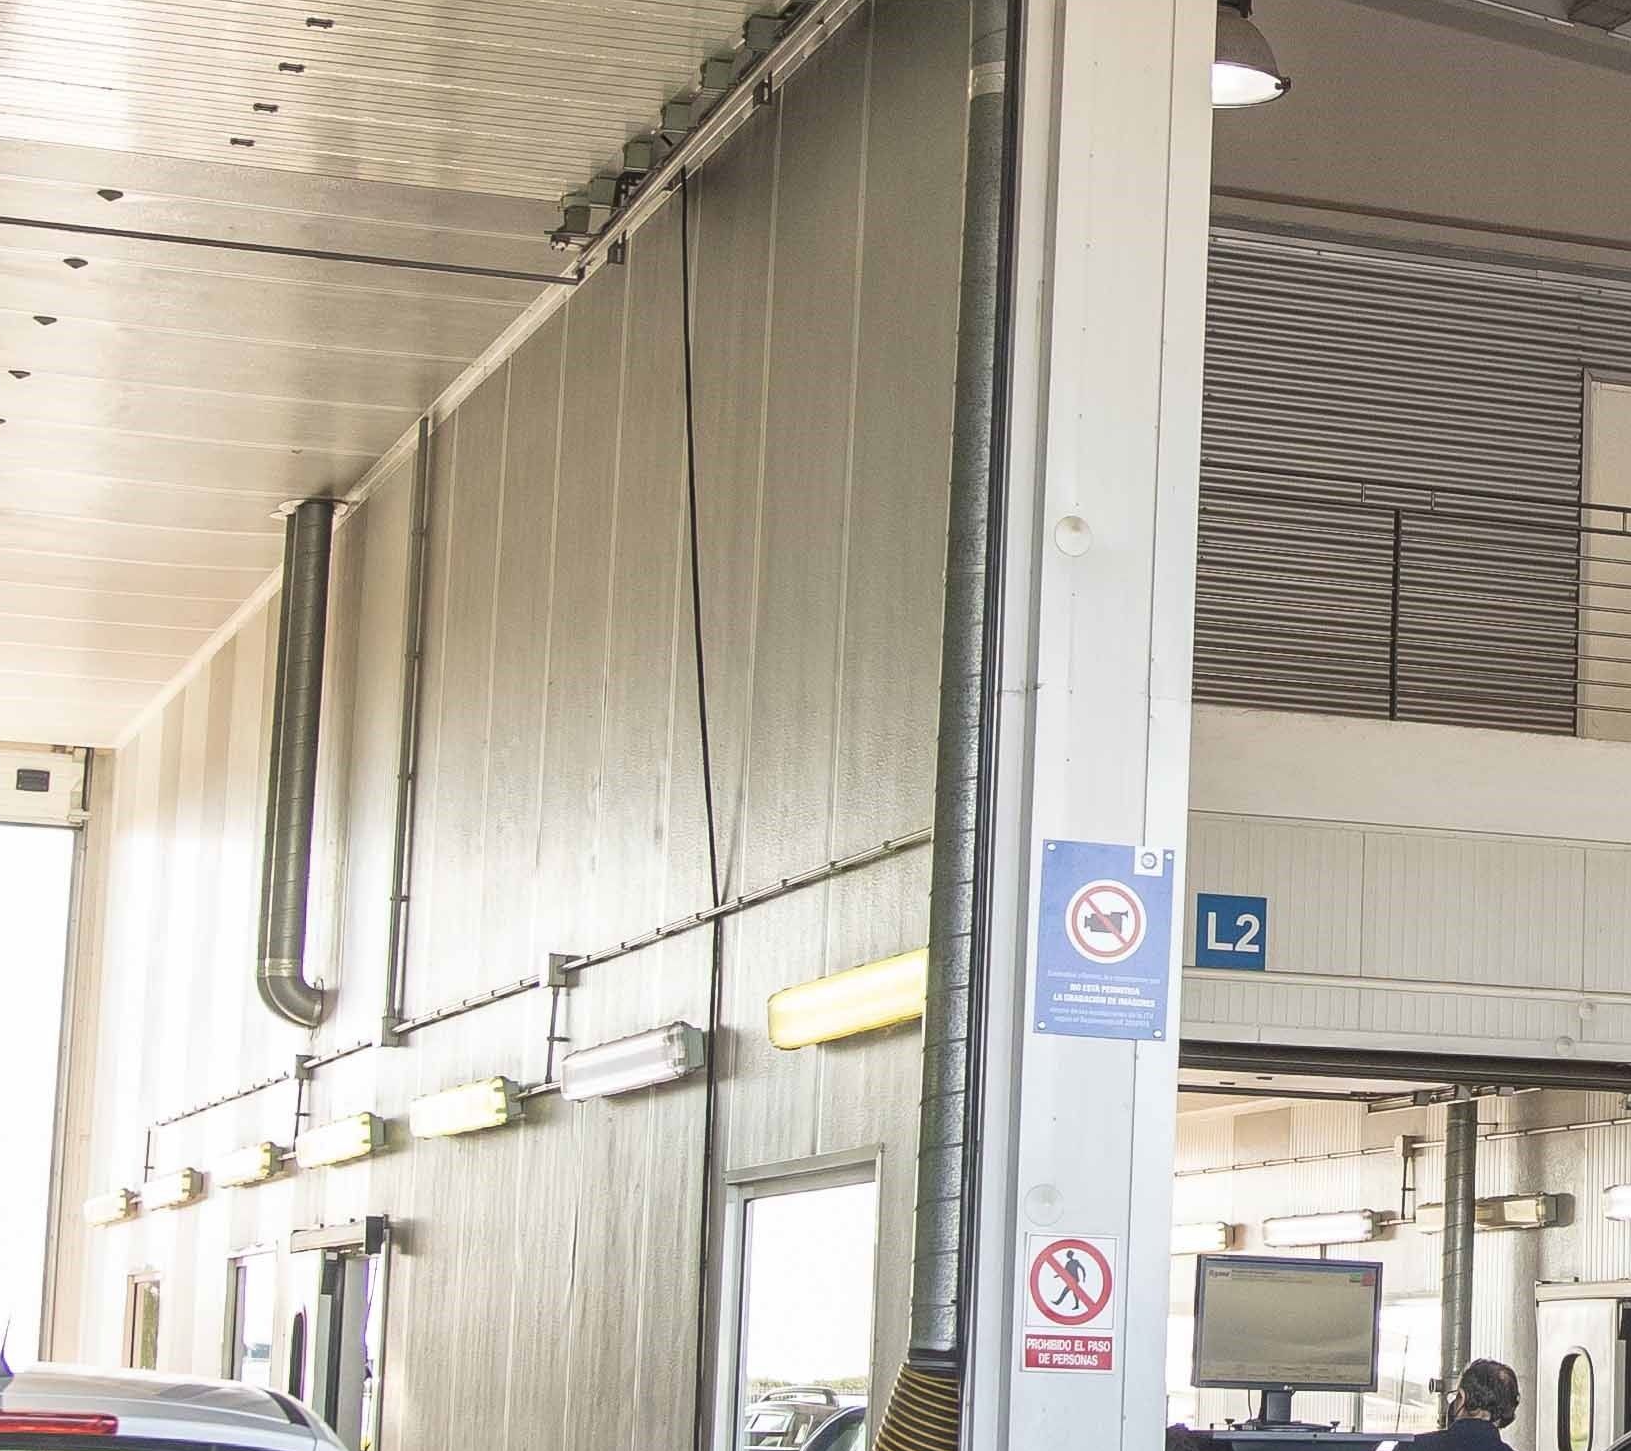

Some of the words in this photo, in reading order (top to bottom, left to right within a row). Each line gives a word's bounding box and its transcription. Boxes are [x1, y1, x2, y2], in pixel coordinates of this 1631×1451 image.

[1206, 911, 1262, 954] L2
[1026, 1337, 1072, 1351] PROHIBIDO
[1074, 1339, 1086, 1352] EL
[1087, 1340, 1111, 1353] PASO
[1038, 1352, 1051, 1365] DE
[1052, 1353, 1099, 1367] PERSONAS
